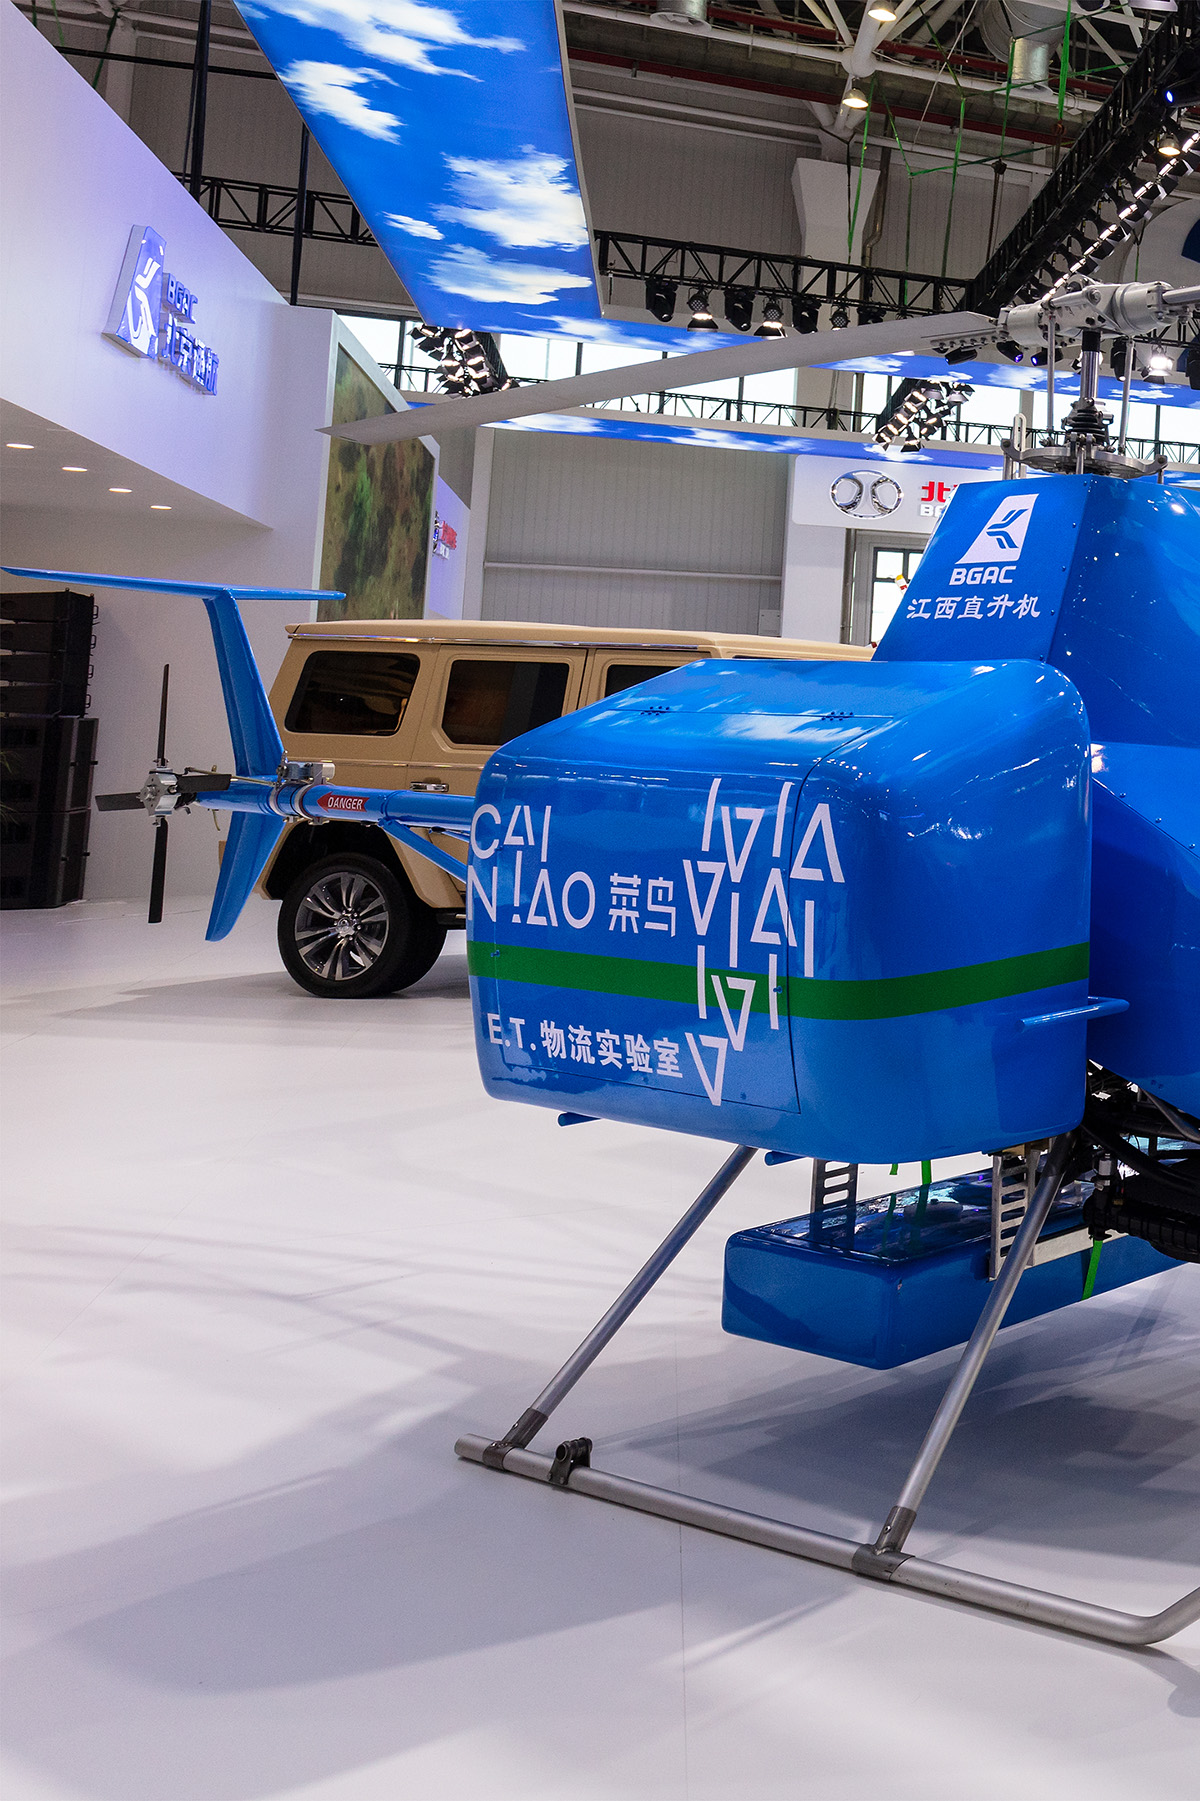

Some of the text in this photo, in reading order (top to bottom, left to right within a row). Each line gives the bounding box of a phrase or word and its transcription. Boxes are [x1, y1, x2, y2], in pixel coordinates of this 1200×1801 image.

[948, 565, 1017, 586] BGAC
[906, 593, 1041, 620] 江西直升机
[327, 796, 364, 810] DANGER
[608, 872, 677, 938] 菜鸟
